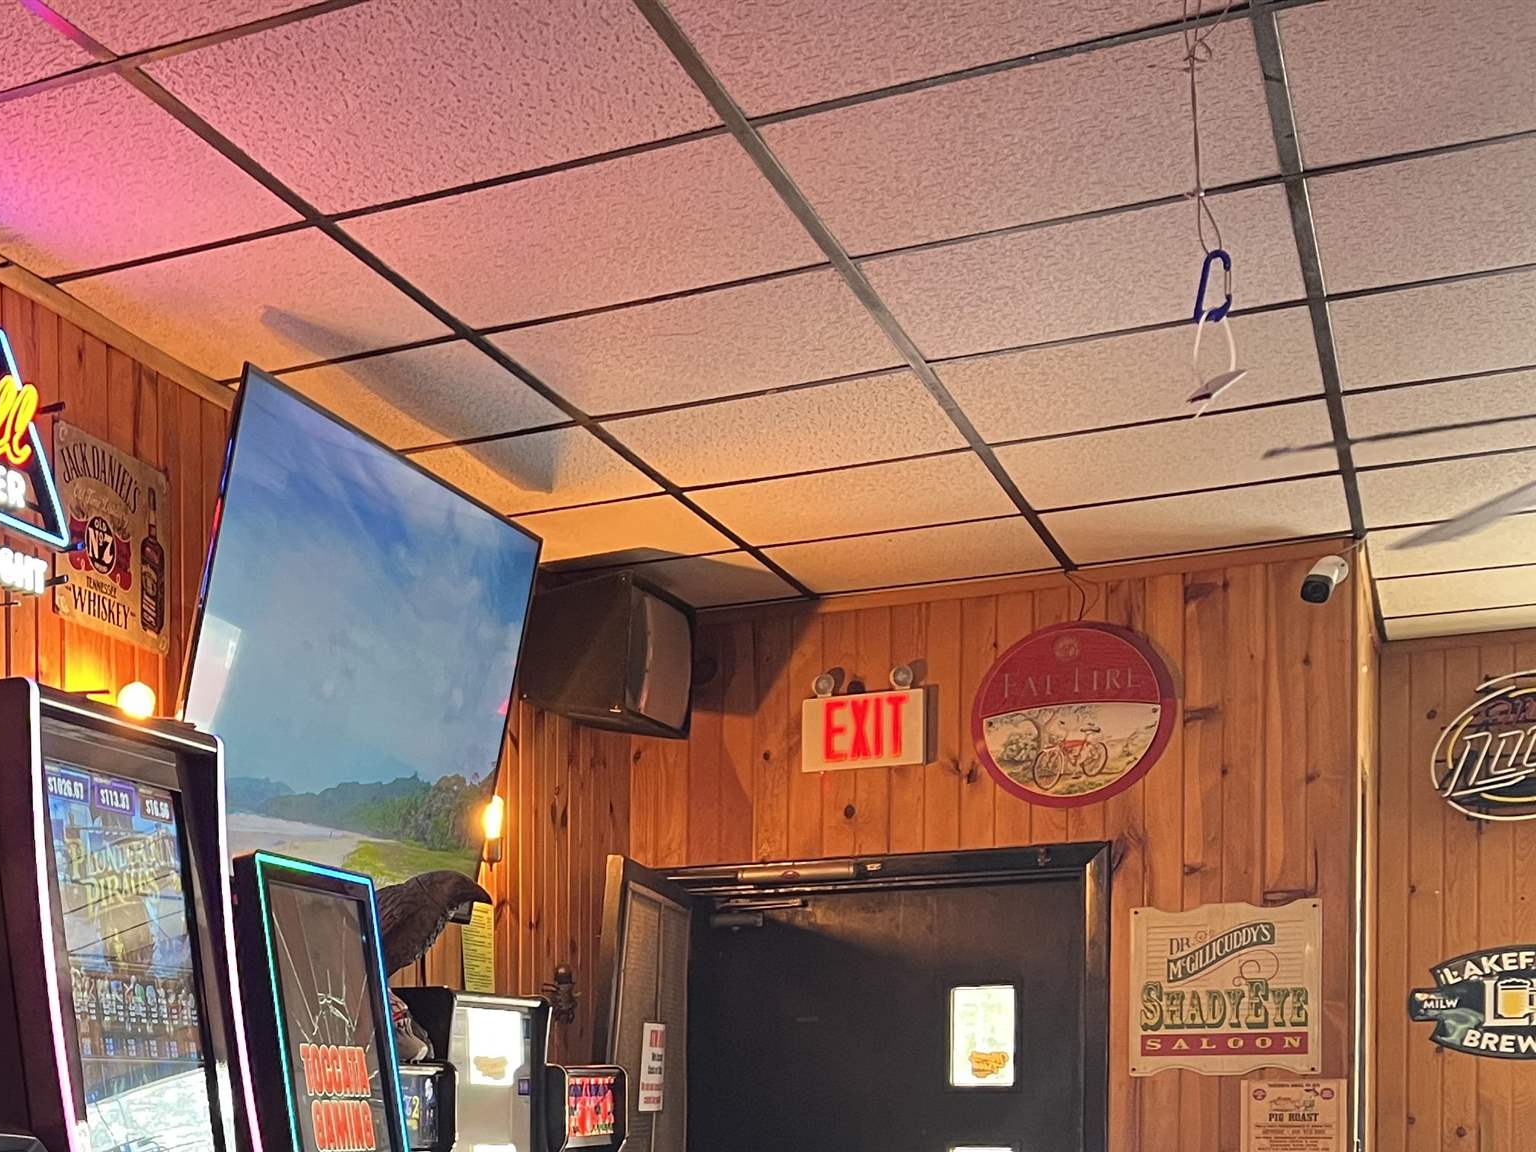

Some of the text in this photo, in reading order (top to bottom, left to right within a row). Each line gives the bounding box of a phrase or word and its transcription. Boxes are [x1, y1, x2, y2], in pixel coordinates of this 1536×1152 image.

[61, 442, 91, 484] JACK
[92, 447, 141, 514] DANIEL'S
[72, 584, 132, 630] WHISKEY
[86, 576, 117, 598] TENNESSEE
[823, 694, 909, 763] EXIT
[1443, 951, 1536, 985] LAKEF
[1424, 996, 1460, 1009] MILW
[1145, 1036, 1302, 1050] SALOON
[1462, 1029, 1536, 1053] BREW
[299, 1043, 371, 1097] TOCCATA
[311, 1099, 376, 1152] GAMING
